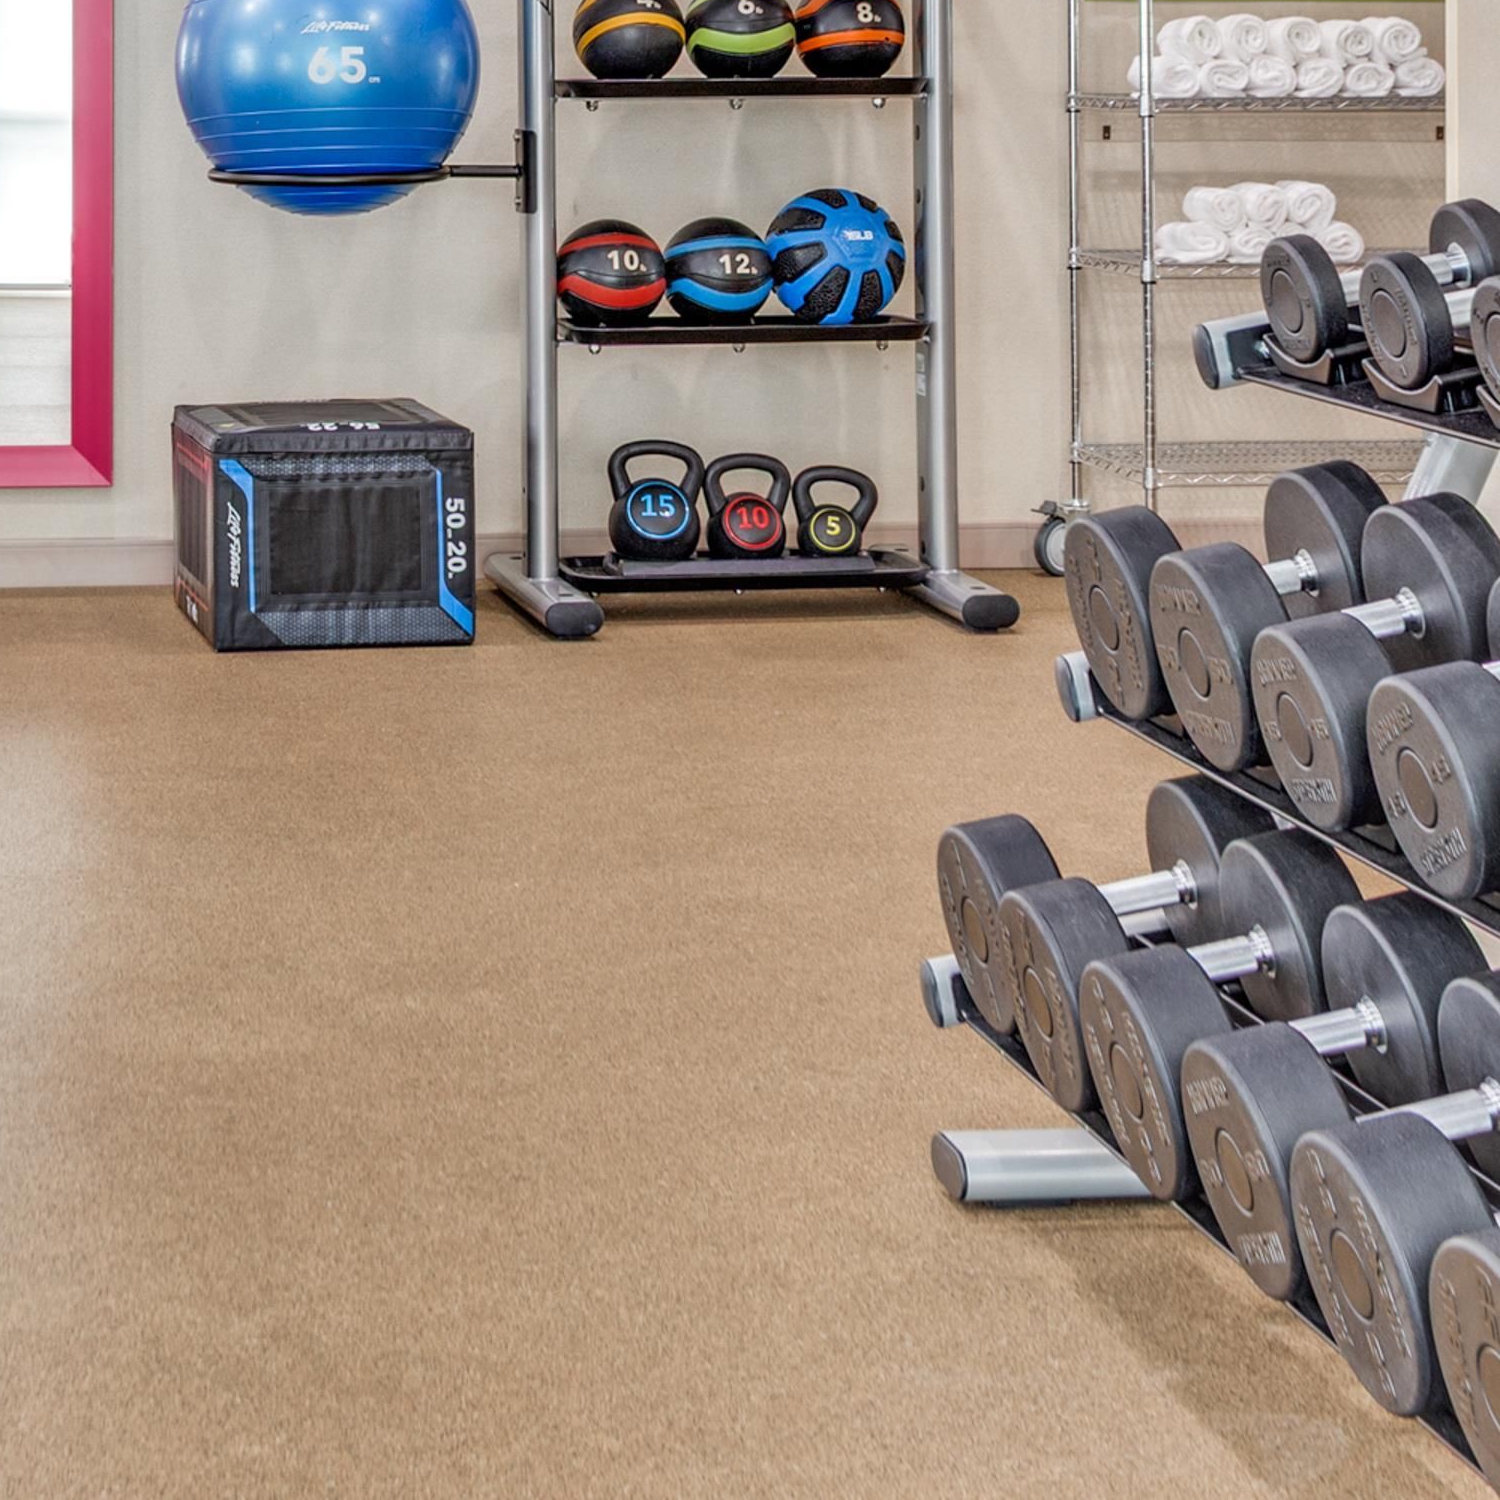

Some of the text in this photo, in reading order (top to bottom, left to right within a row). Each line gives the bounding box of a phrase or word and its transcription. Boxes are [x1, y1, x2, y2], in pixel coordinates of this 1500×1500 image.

[307, 46, 367, 85] 65
[640, 494, 676, 517] 15
[736, 506, 770, 530] 10
[825, 516, 842, 536] 5
